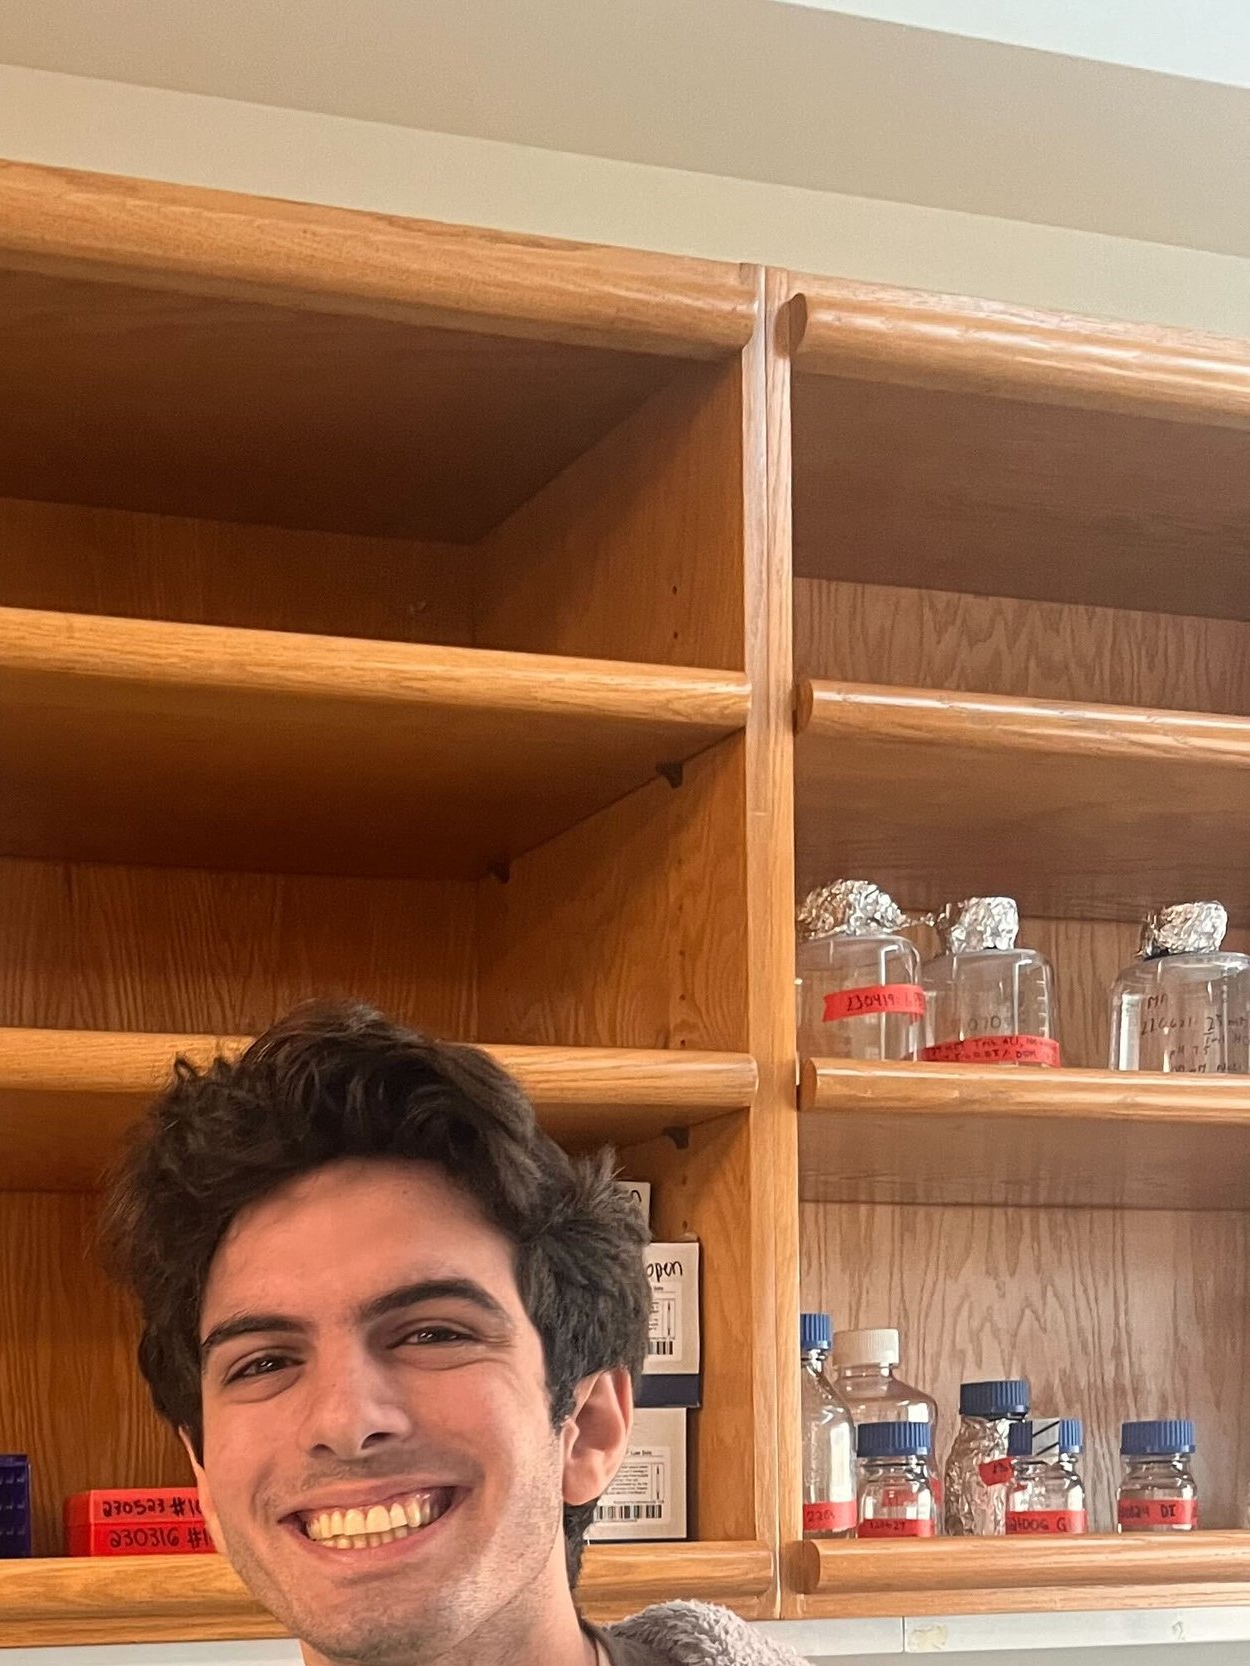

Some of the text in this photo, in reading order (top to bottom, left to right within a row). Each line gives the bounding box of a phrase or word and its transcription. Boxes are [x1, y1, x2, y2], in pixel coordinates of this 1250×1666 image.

[646, 1261, 683, 1282] open
[102, 1499, 166, 1517] 230523
[110, 1527, 212, 1549] 230316 #1
